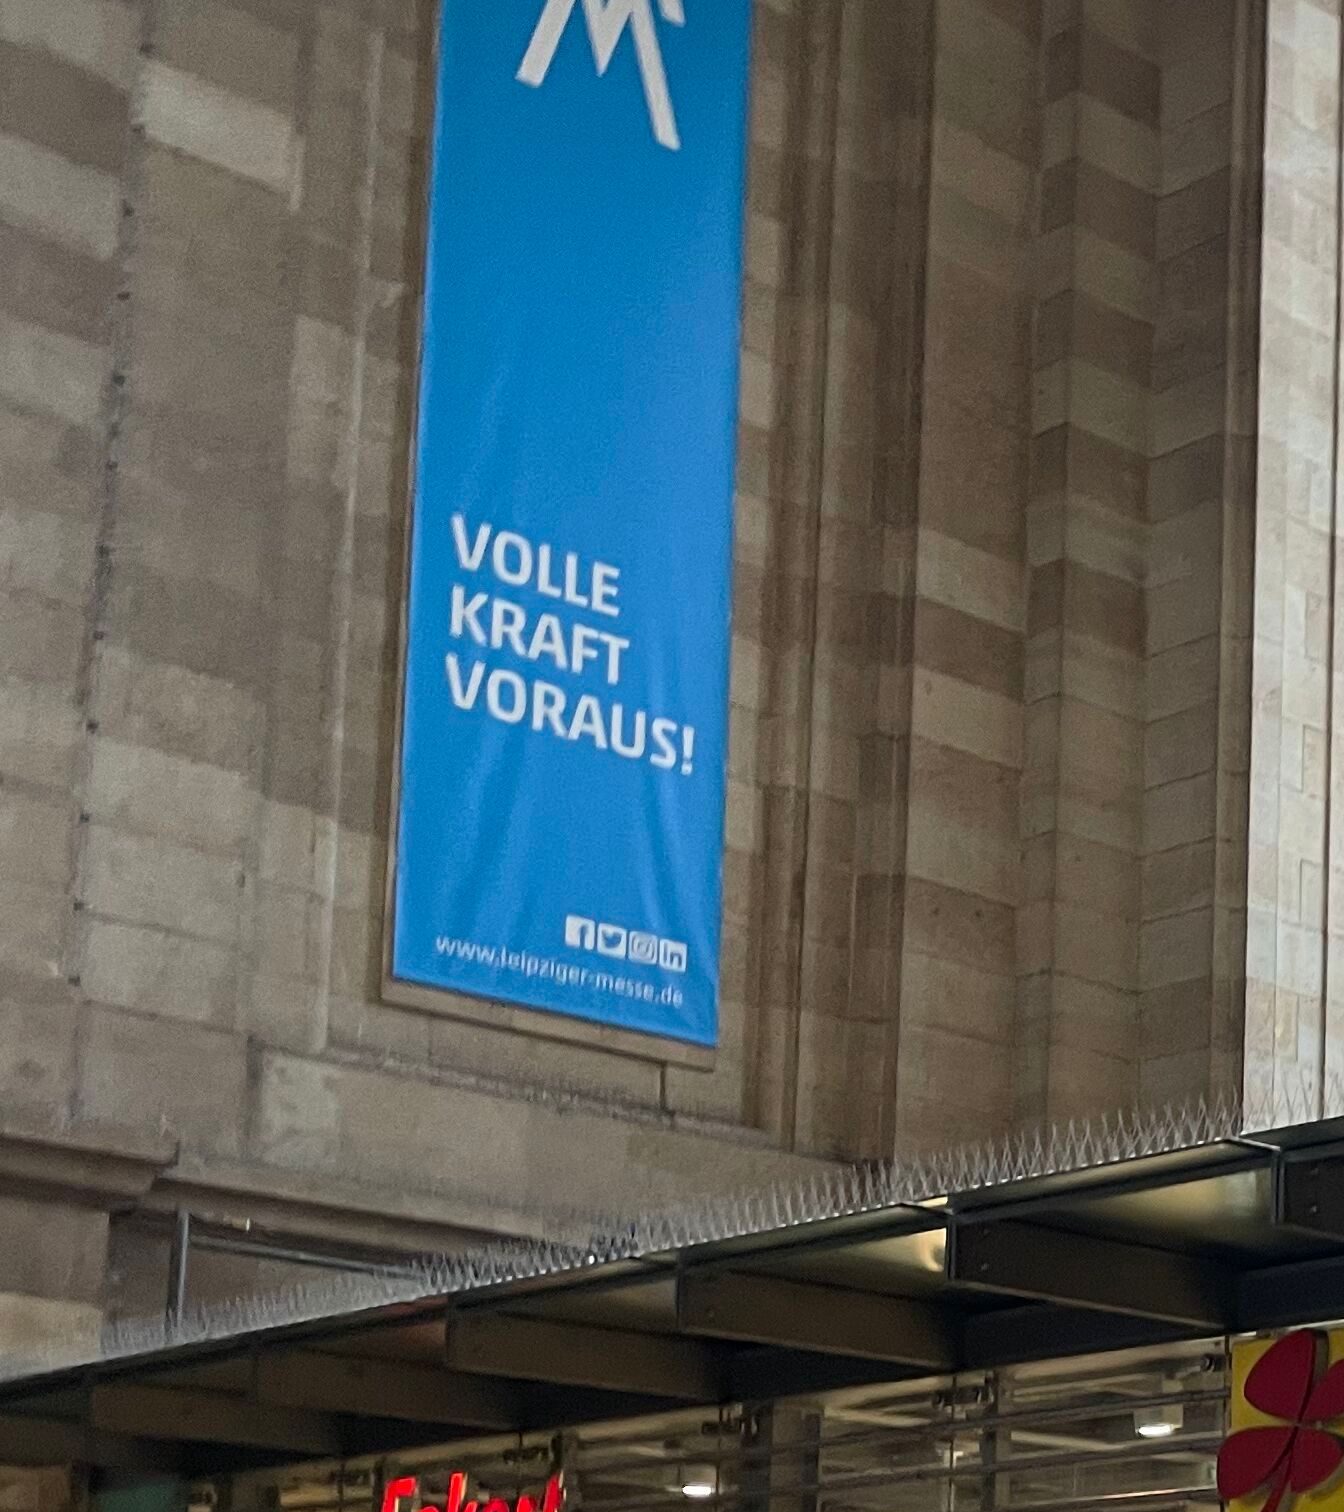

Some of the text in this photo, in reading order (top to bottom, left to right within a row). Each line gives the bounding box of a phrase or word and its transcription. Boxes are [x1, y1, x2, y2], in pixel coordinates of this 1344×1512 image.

[451, 512, 621, 617] VOLLE
[449, 585, 630, 685] KRAFT
[445, 653, 695, 776] VORAUS!
[435, 935, 685, 1008] www.leipziger-messe.de
